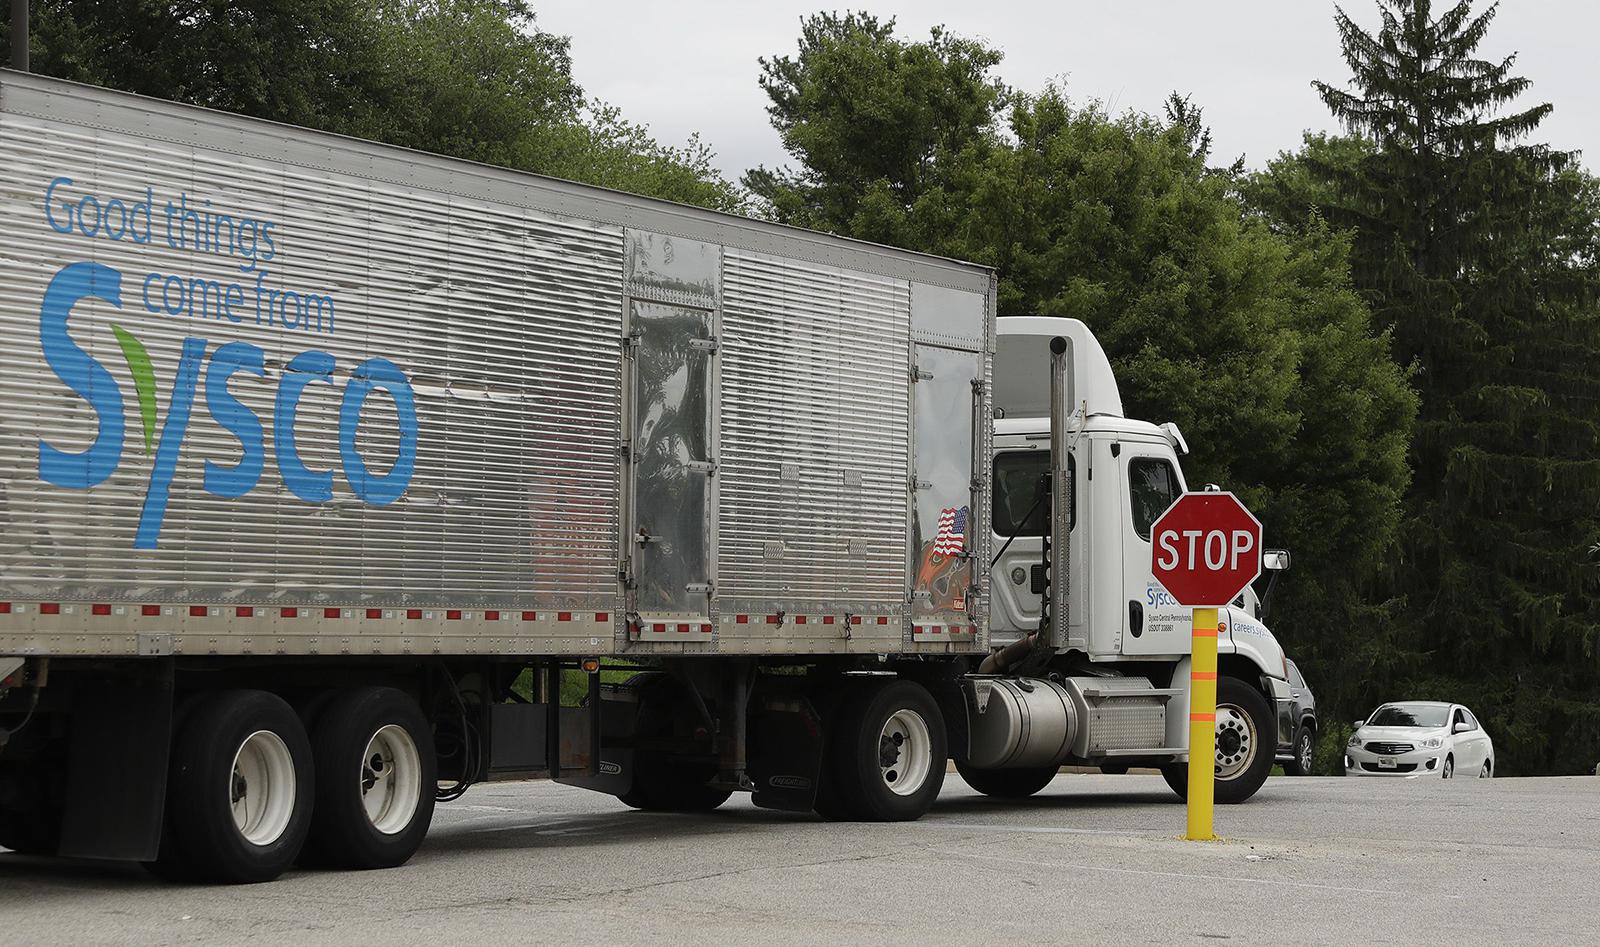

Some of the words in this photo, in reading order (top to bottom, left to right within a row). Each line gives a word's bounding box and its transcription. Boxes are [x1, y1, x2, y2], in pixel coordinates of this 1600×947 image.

[44, 176, 153, 244] Good
[164, 192, 276, 272] things
[143, 272, 244, 323] come
[254, 270, 335, 334] from
[38, 261, 418, 549] Sysco
[1157, 529, 1254, 571] STOP
